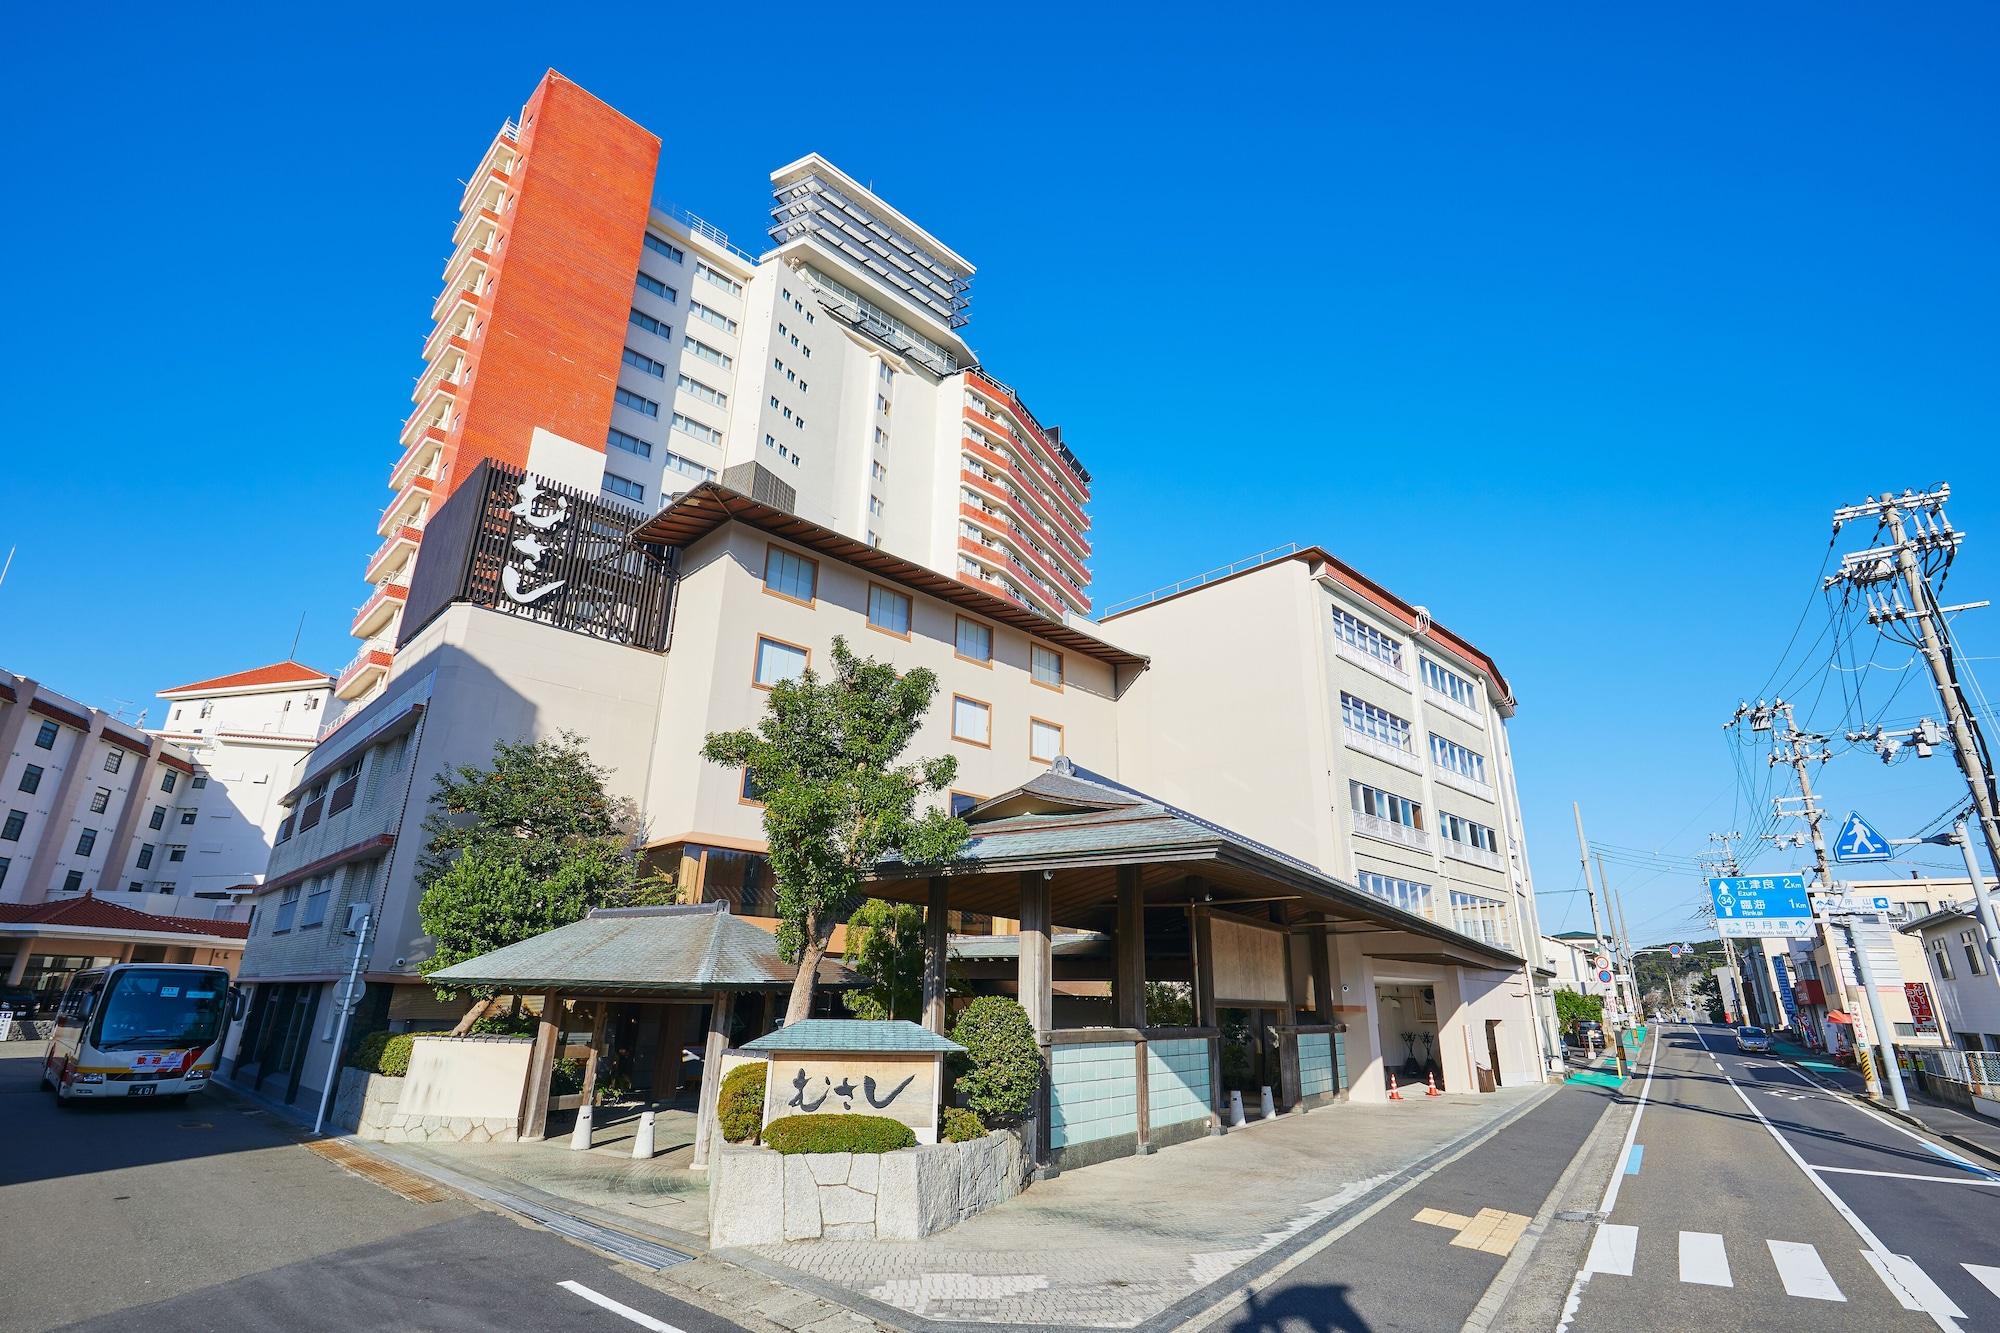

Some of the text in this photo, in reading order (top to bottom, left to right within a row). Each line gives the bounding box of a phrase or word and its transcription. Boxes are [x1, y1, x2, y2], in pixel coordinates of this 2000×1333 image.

[502, 473, 570, 604] むさし
[1736, 879, 1775, 890] 江津良
[1720, 896, 1732, 905] 34
[1740, 899, 1766, 910] 臨海
[1746, 920, 1789, 930] 円月島
[1915, 1016, 1931, 1025] P
[137, 1087, 154, 1096] 401
[788, 1067, 916, 1113] むさし
